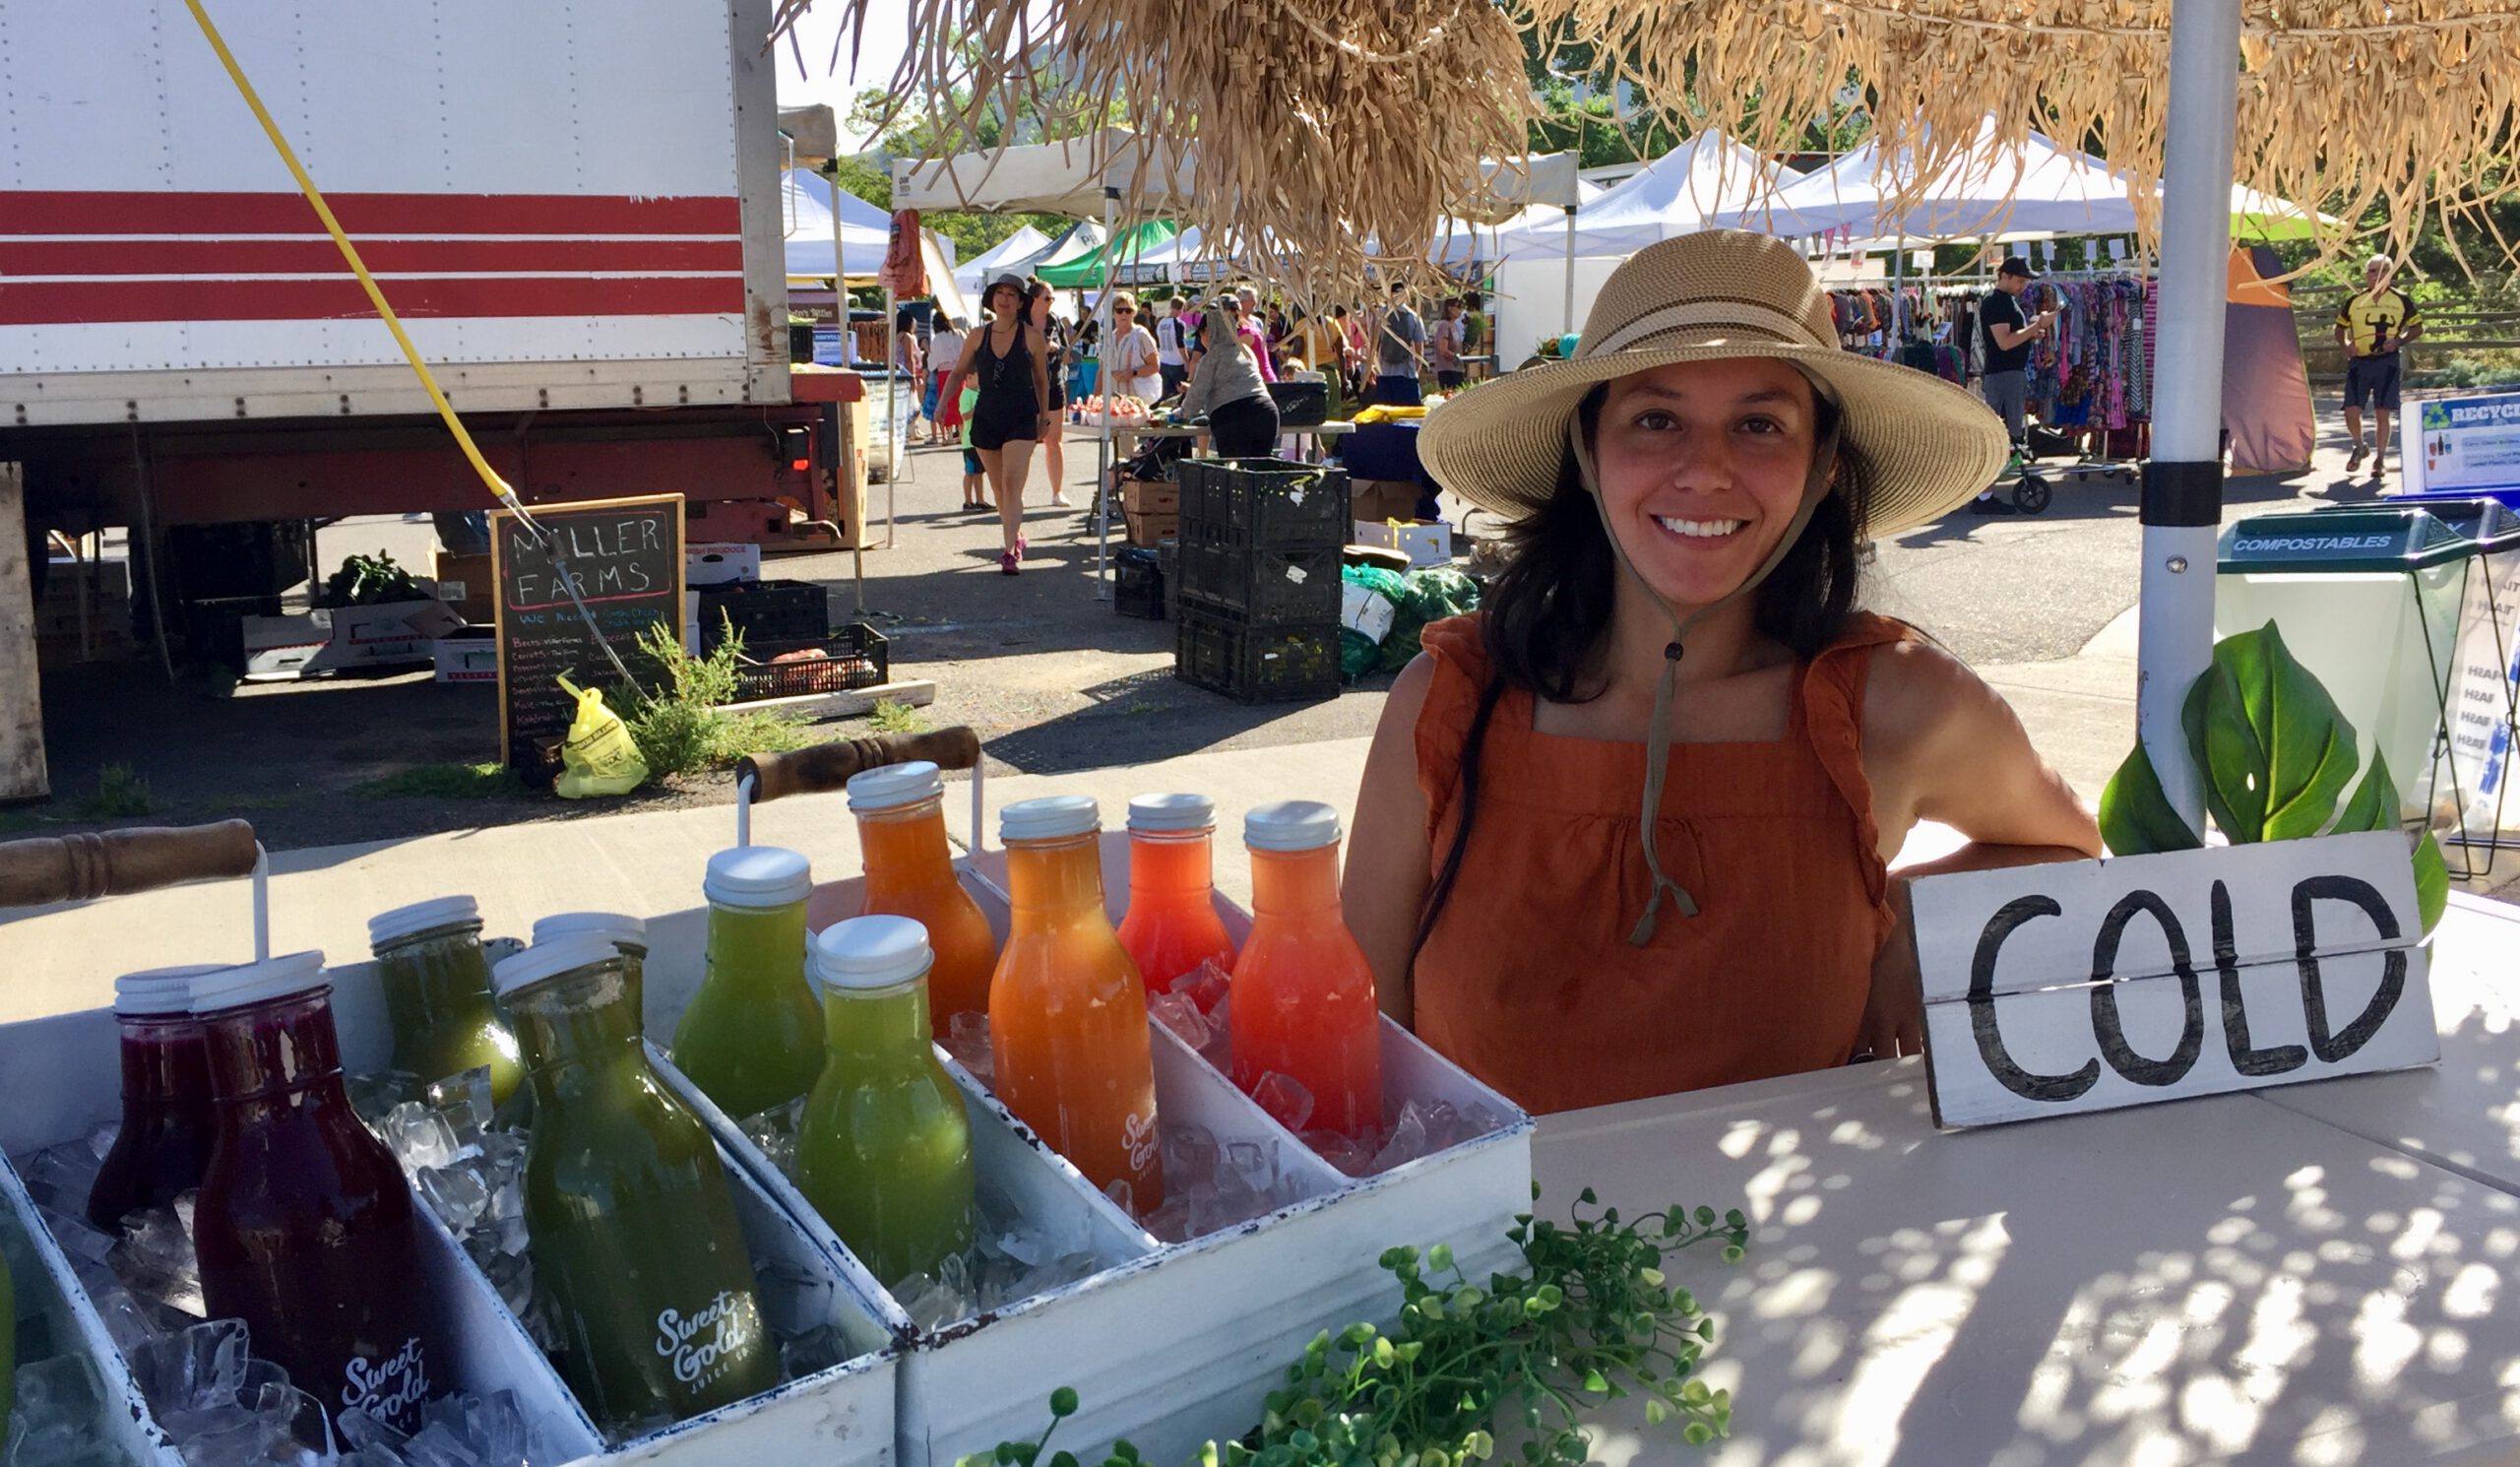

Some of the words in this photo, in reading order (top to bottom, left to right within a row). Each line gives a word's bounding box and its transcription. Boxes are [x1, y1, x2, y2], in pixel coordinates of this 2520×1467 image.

[513, 519, 660, 565] MLLER
[2233, 536, 2392, 552] COMPOSTABLES
[518, 562, 651, 605] FARMS
[1967, 875, 2408, 1102] COLD
[656, 1291, 737, 1357] Sweet
[673, 1311, 747, 1381] Gold
[342, 1337, 424, 1406] Sweet
[360, 1360, 430, 1424] Gold
[691, 1362, 729, 1394] JUICE
